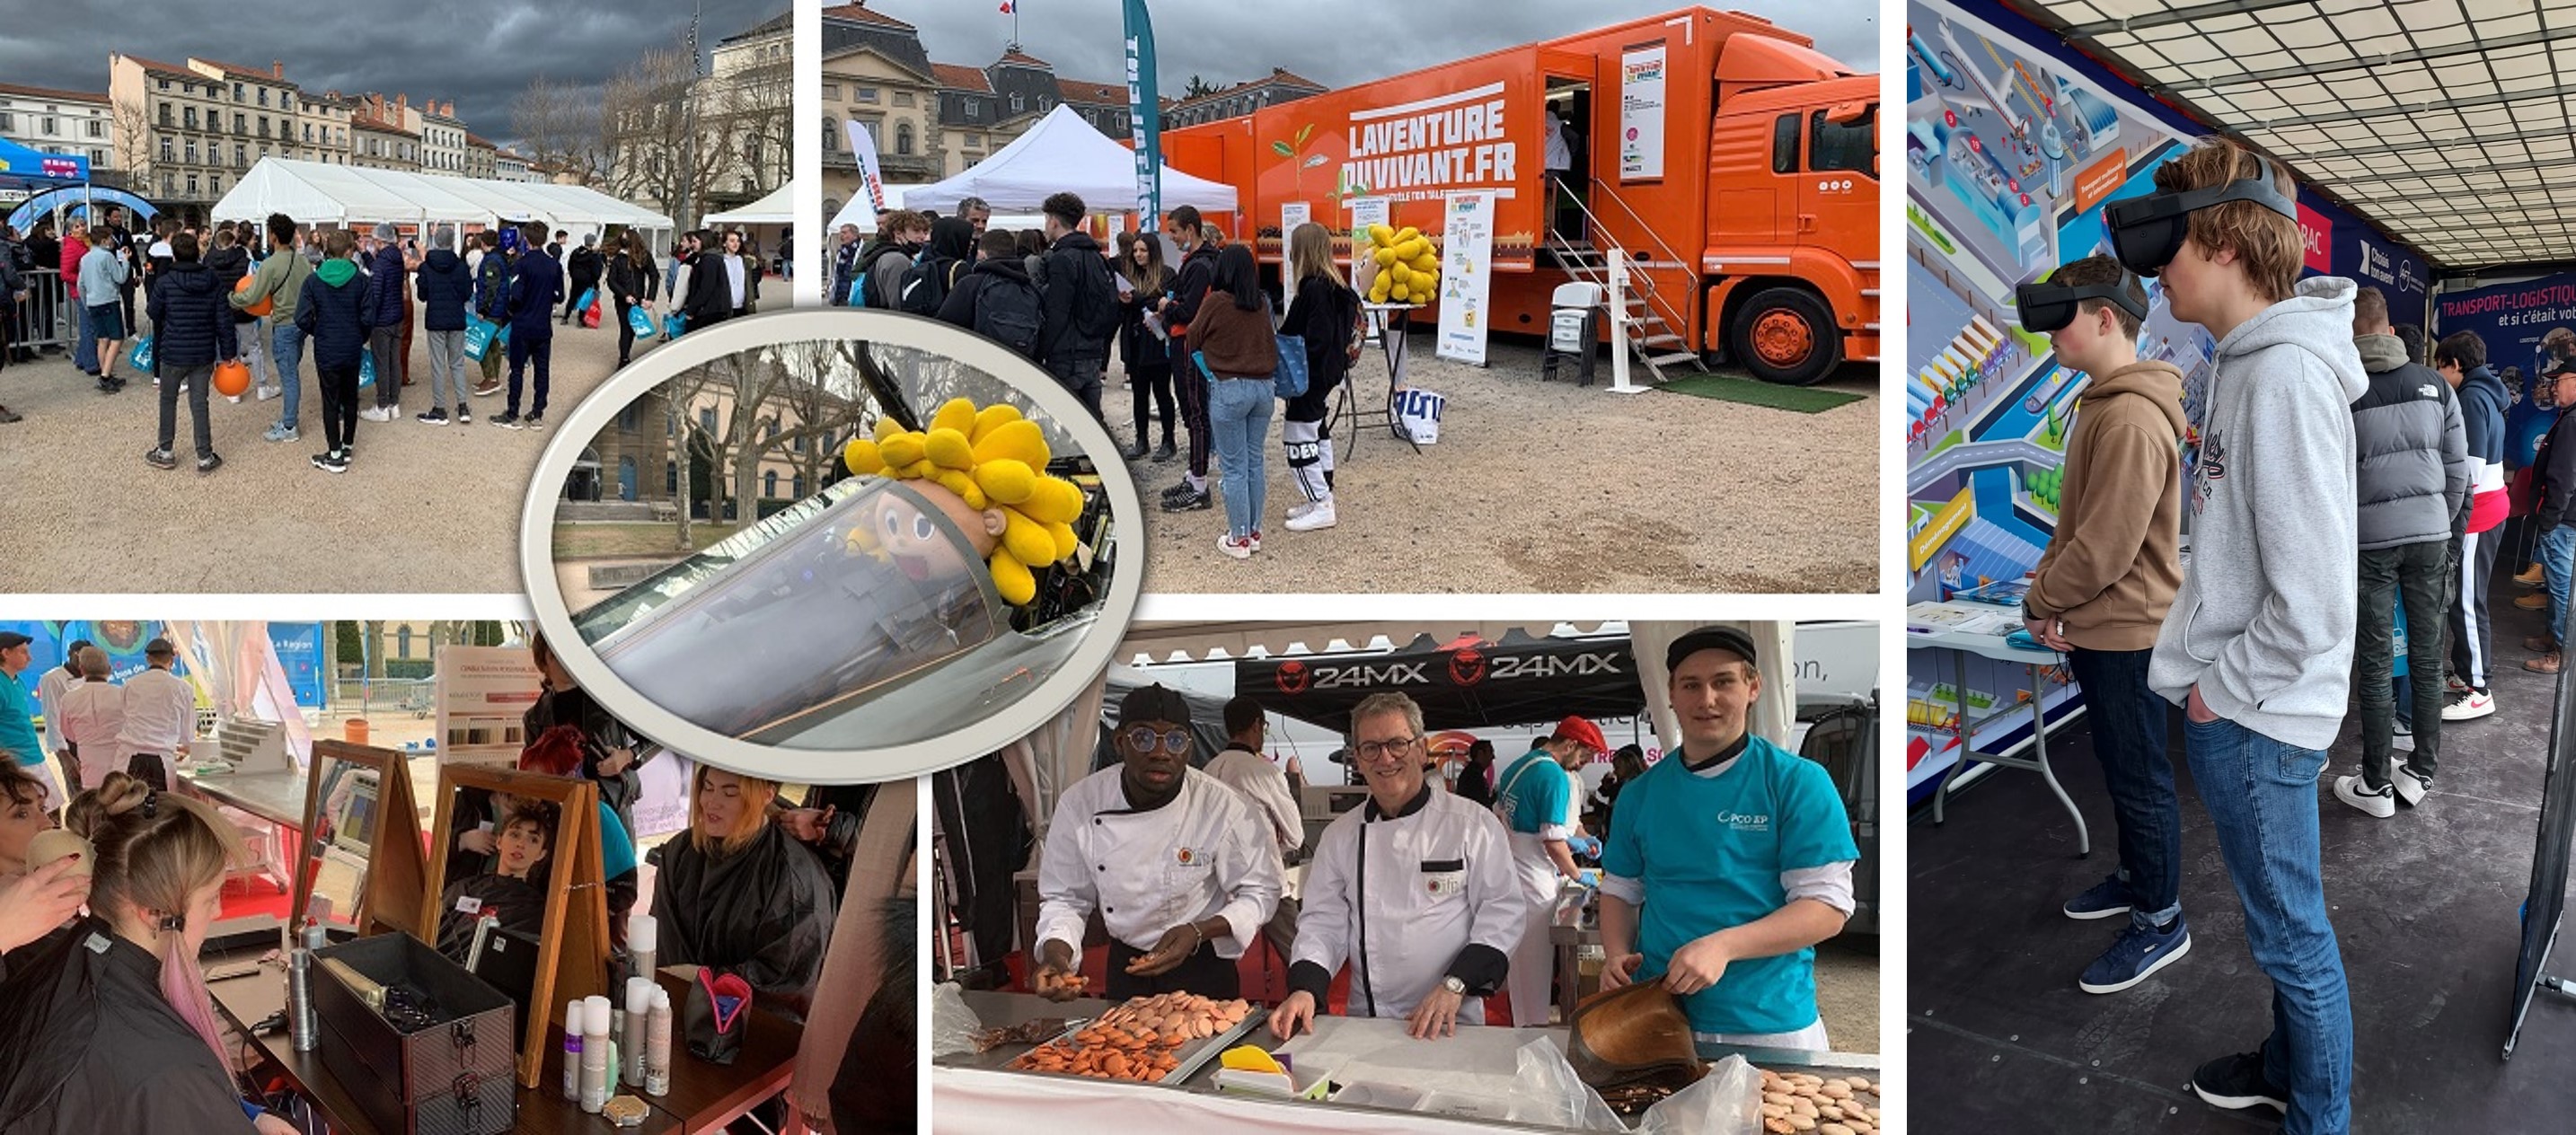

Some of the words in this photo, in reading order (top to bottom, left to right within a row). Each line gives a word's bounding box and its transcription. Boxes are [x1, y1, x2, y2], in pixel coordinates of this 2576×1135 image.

[1349, 100, 1505, 158] LAVENTURE
[1342, 142, 1516, 194] DUVIVANT.FR
[1426, 189, 1445, 200] TALE
[2301, 224, 2322, 255] BAC
[2371, 247, 2390, 269] Choisis
[2379, 269, 2395, 286] avenir
[2499, 314, 2509, 326] et
[2511, 312, 2519, 325] si
[1919, 502, 1967, 555] Déménagement
[1314, 662, 1429, 689] 24MX
[1490, 652, 1621, 679] 24MX
